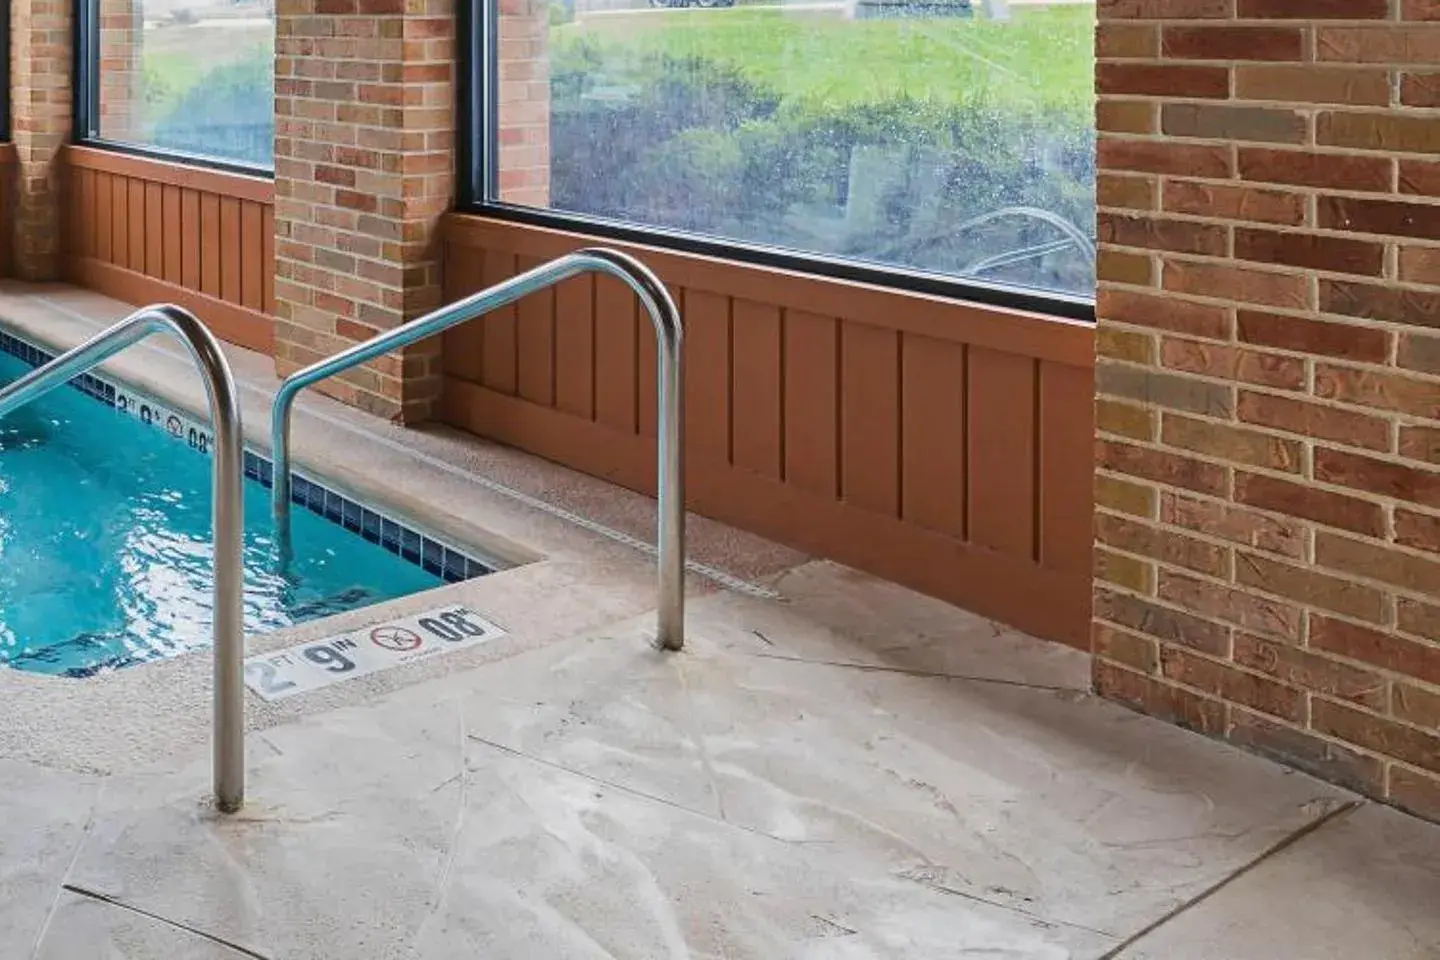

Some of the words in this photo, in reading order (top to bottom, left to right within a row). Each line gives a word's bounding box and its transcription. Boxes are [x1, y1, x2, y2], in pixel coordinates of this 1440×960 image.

[244, 661, 297, 694] 2
[303, 645, 356, 672] 9
[331, 638, 358, 652] IN
